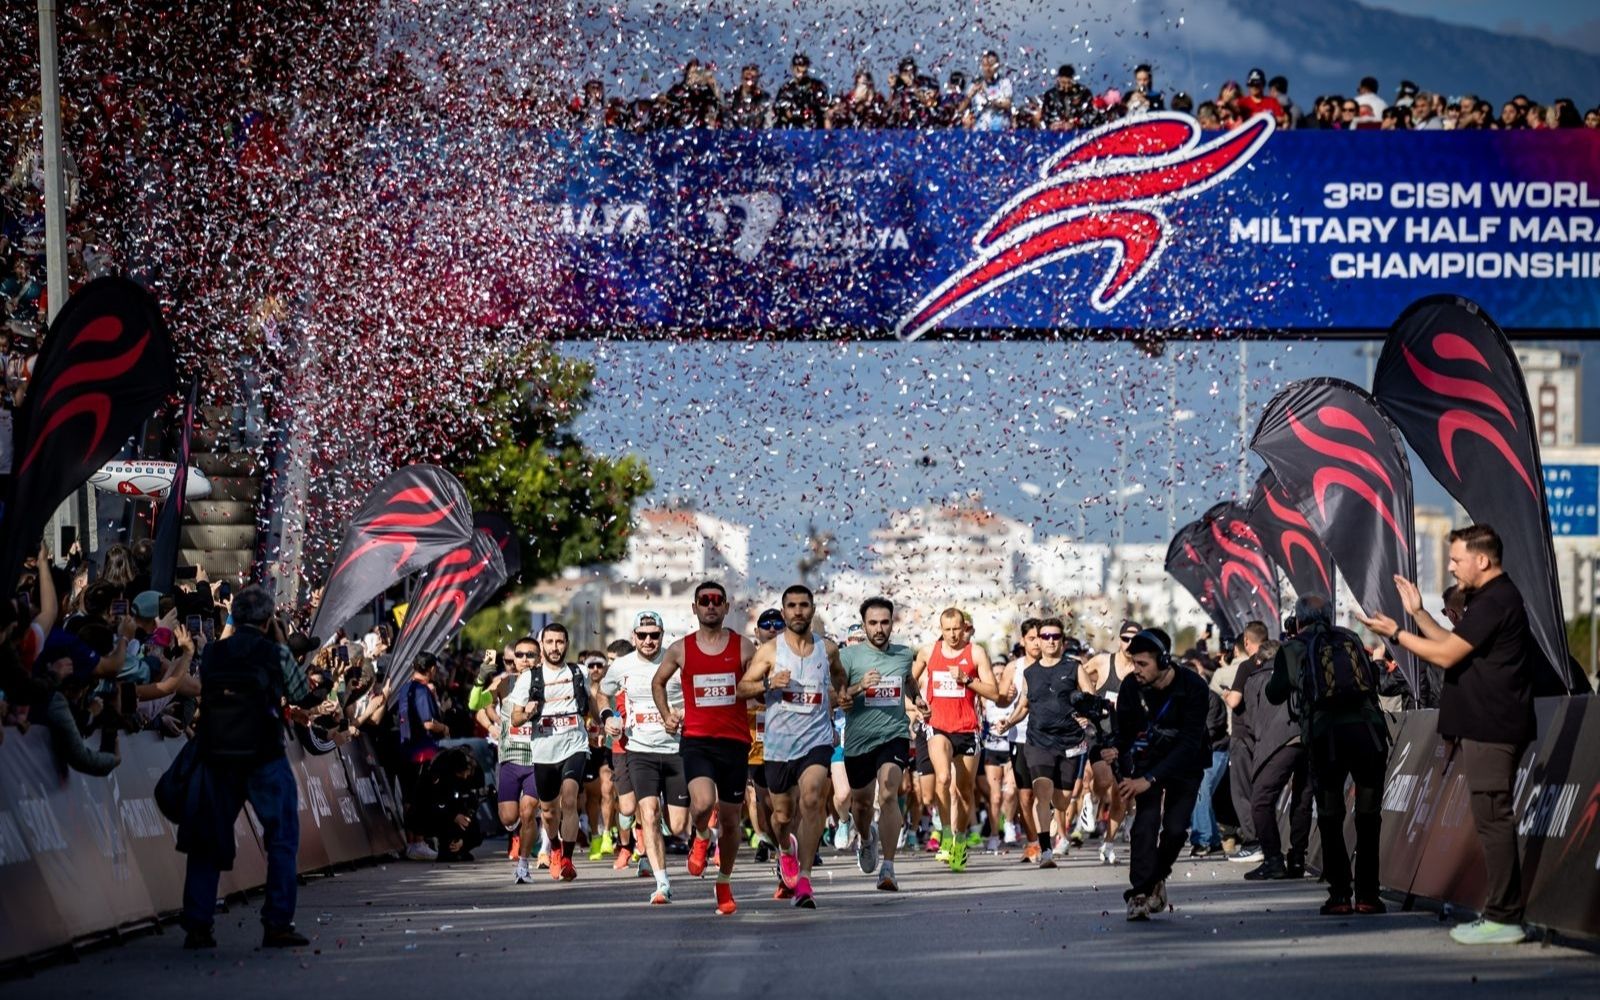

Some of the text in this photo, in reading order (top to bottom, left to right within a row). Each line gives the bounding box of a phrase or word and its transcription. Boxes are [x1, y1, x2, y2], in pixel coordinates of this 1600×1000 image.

[1323, 182, 1600, 209] 3RD CISM WORL
[1229, 216, 1398, 244] MILITARY
[1405, 216, 1501, 244] HALF
[704, 686, 727, 697] 283
[875, 687, 896, 697] 209
[792, 692, 816, 703] 287
[552, 716, 570, 727] 285
[518, 727, 532, 735] 31
